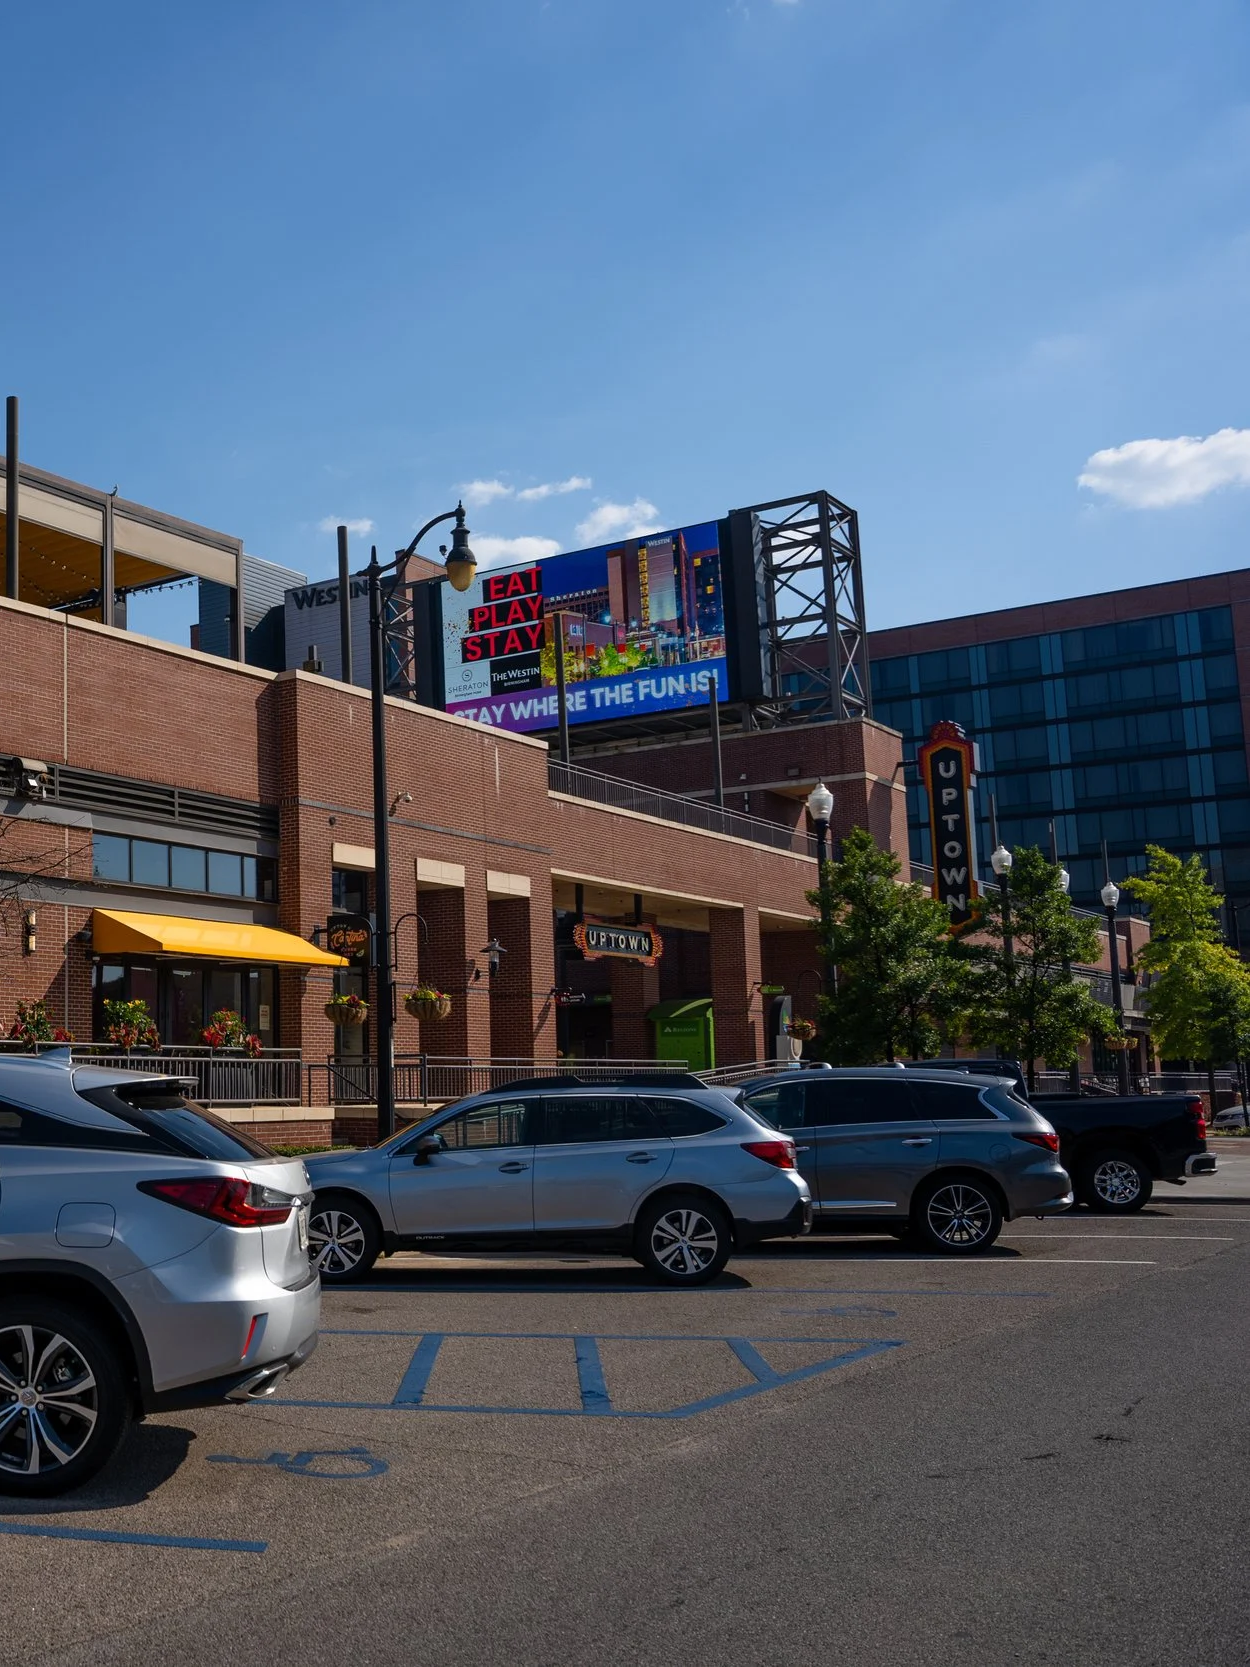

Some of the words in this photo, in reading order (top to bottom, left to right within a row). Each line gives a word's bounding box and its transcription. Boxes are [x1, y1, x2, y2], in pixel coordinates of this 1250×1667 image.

[292, 579, 369, 610] WESIN
[489, 566, 542, 600] EAT
[473, 594, 543, 632] PLAY
[466, 623, 543, 660] STAY
[448, 681, 489, 694] SHERATON
[491, 672, 508, 682] THE
[507, 666, 540, 679] WESTIN
[510, 690, 587, 720] WHERE
[590, 685, 635, 708] THE
[638, 676, 685, 700] FUN
[690, 668, 719, 693] IS!
[938, 760, 968, 912] UPTOWN
[589, 930, 649, 951] UPTOWN
